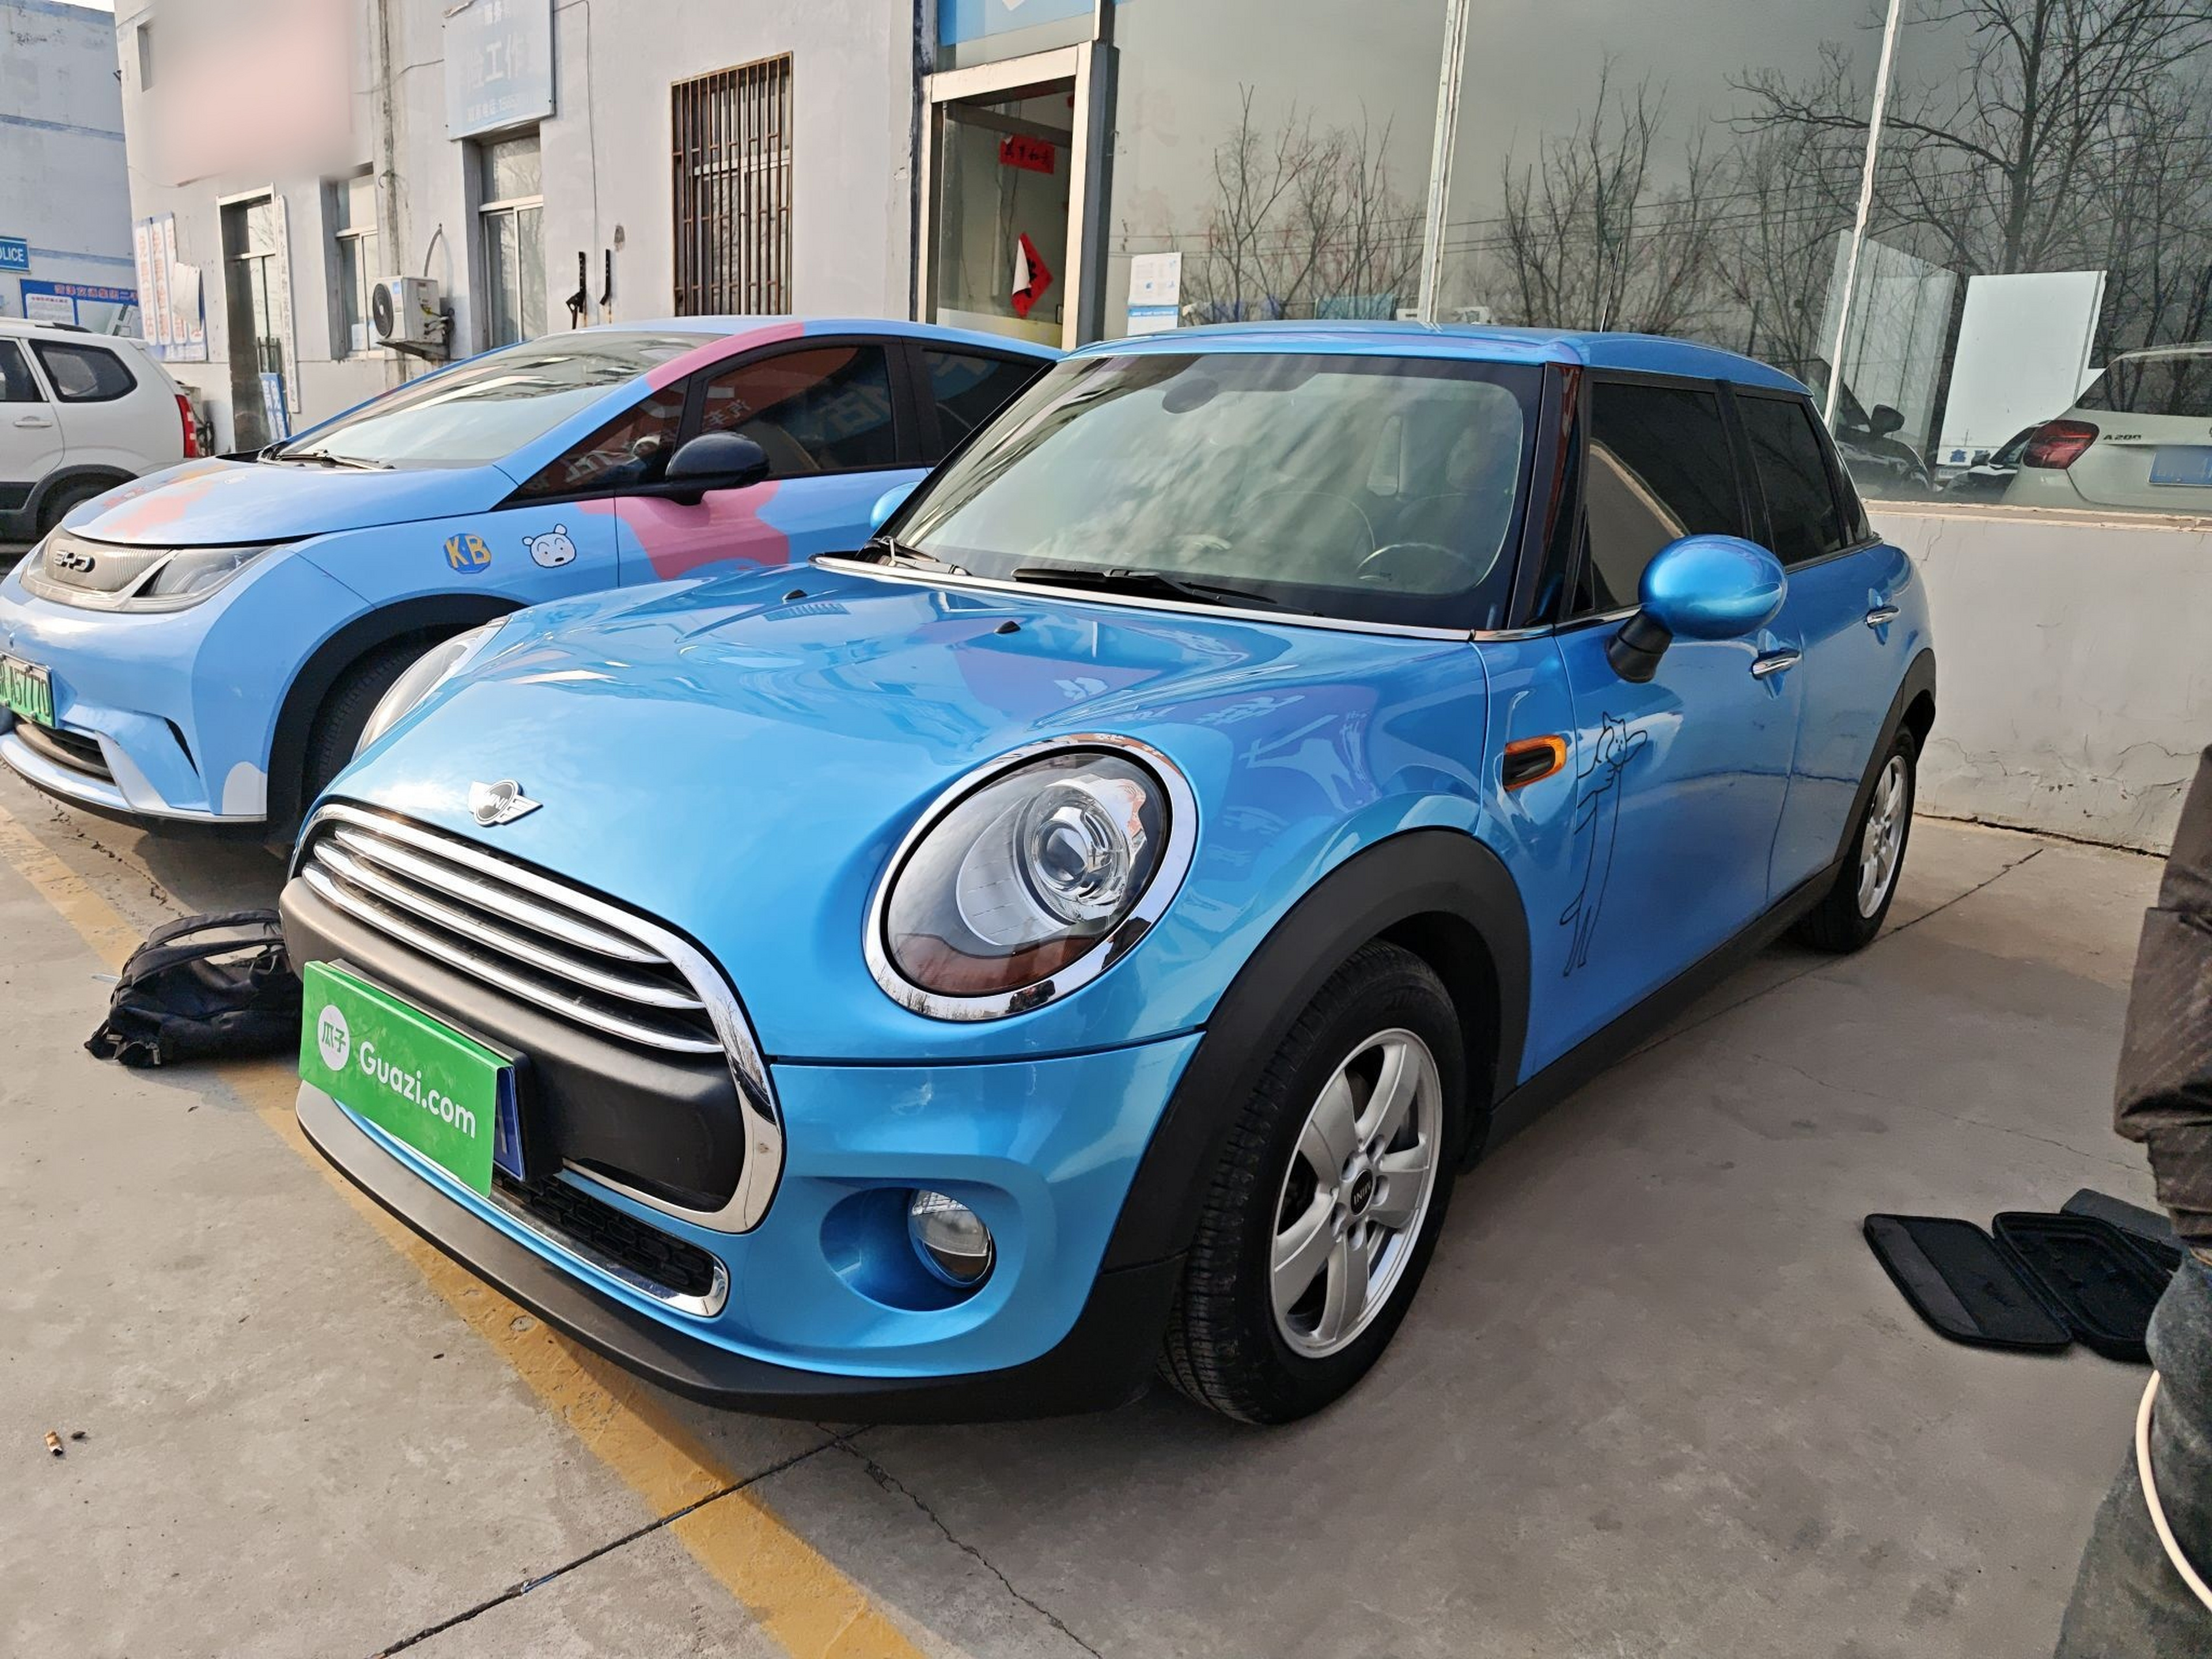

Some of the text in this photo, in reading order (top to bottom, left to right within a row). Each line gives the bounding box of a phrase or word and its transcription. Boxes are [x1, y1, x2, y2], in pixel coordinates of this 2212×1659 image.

[445, 535, 491, 569] KB
[321, 1021, 347, 1053] 瓜子
[359, 1040, 476, 1139] Guazi.com
